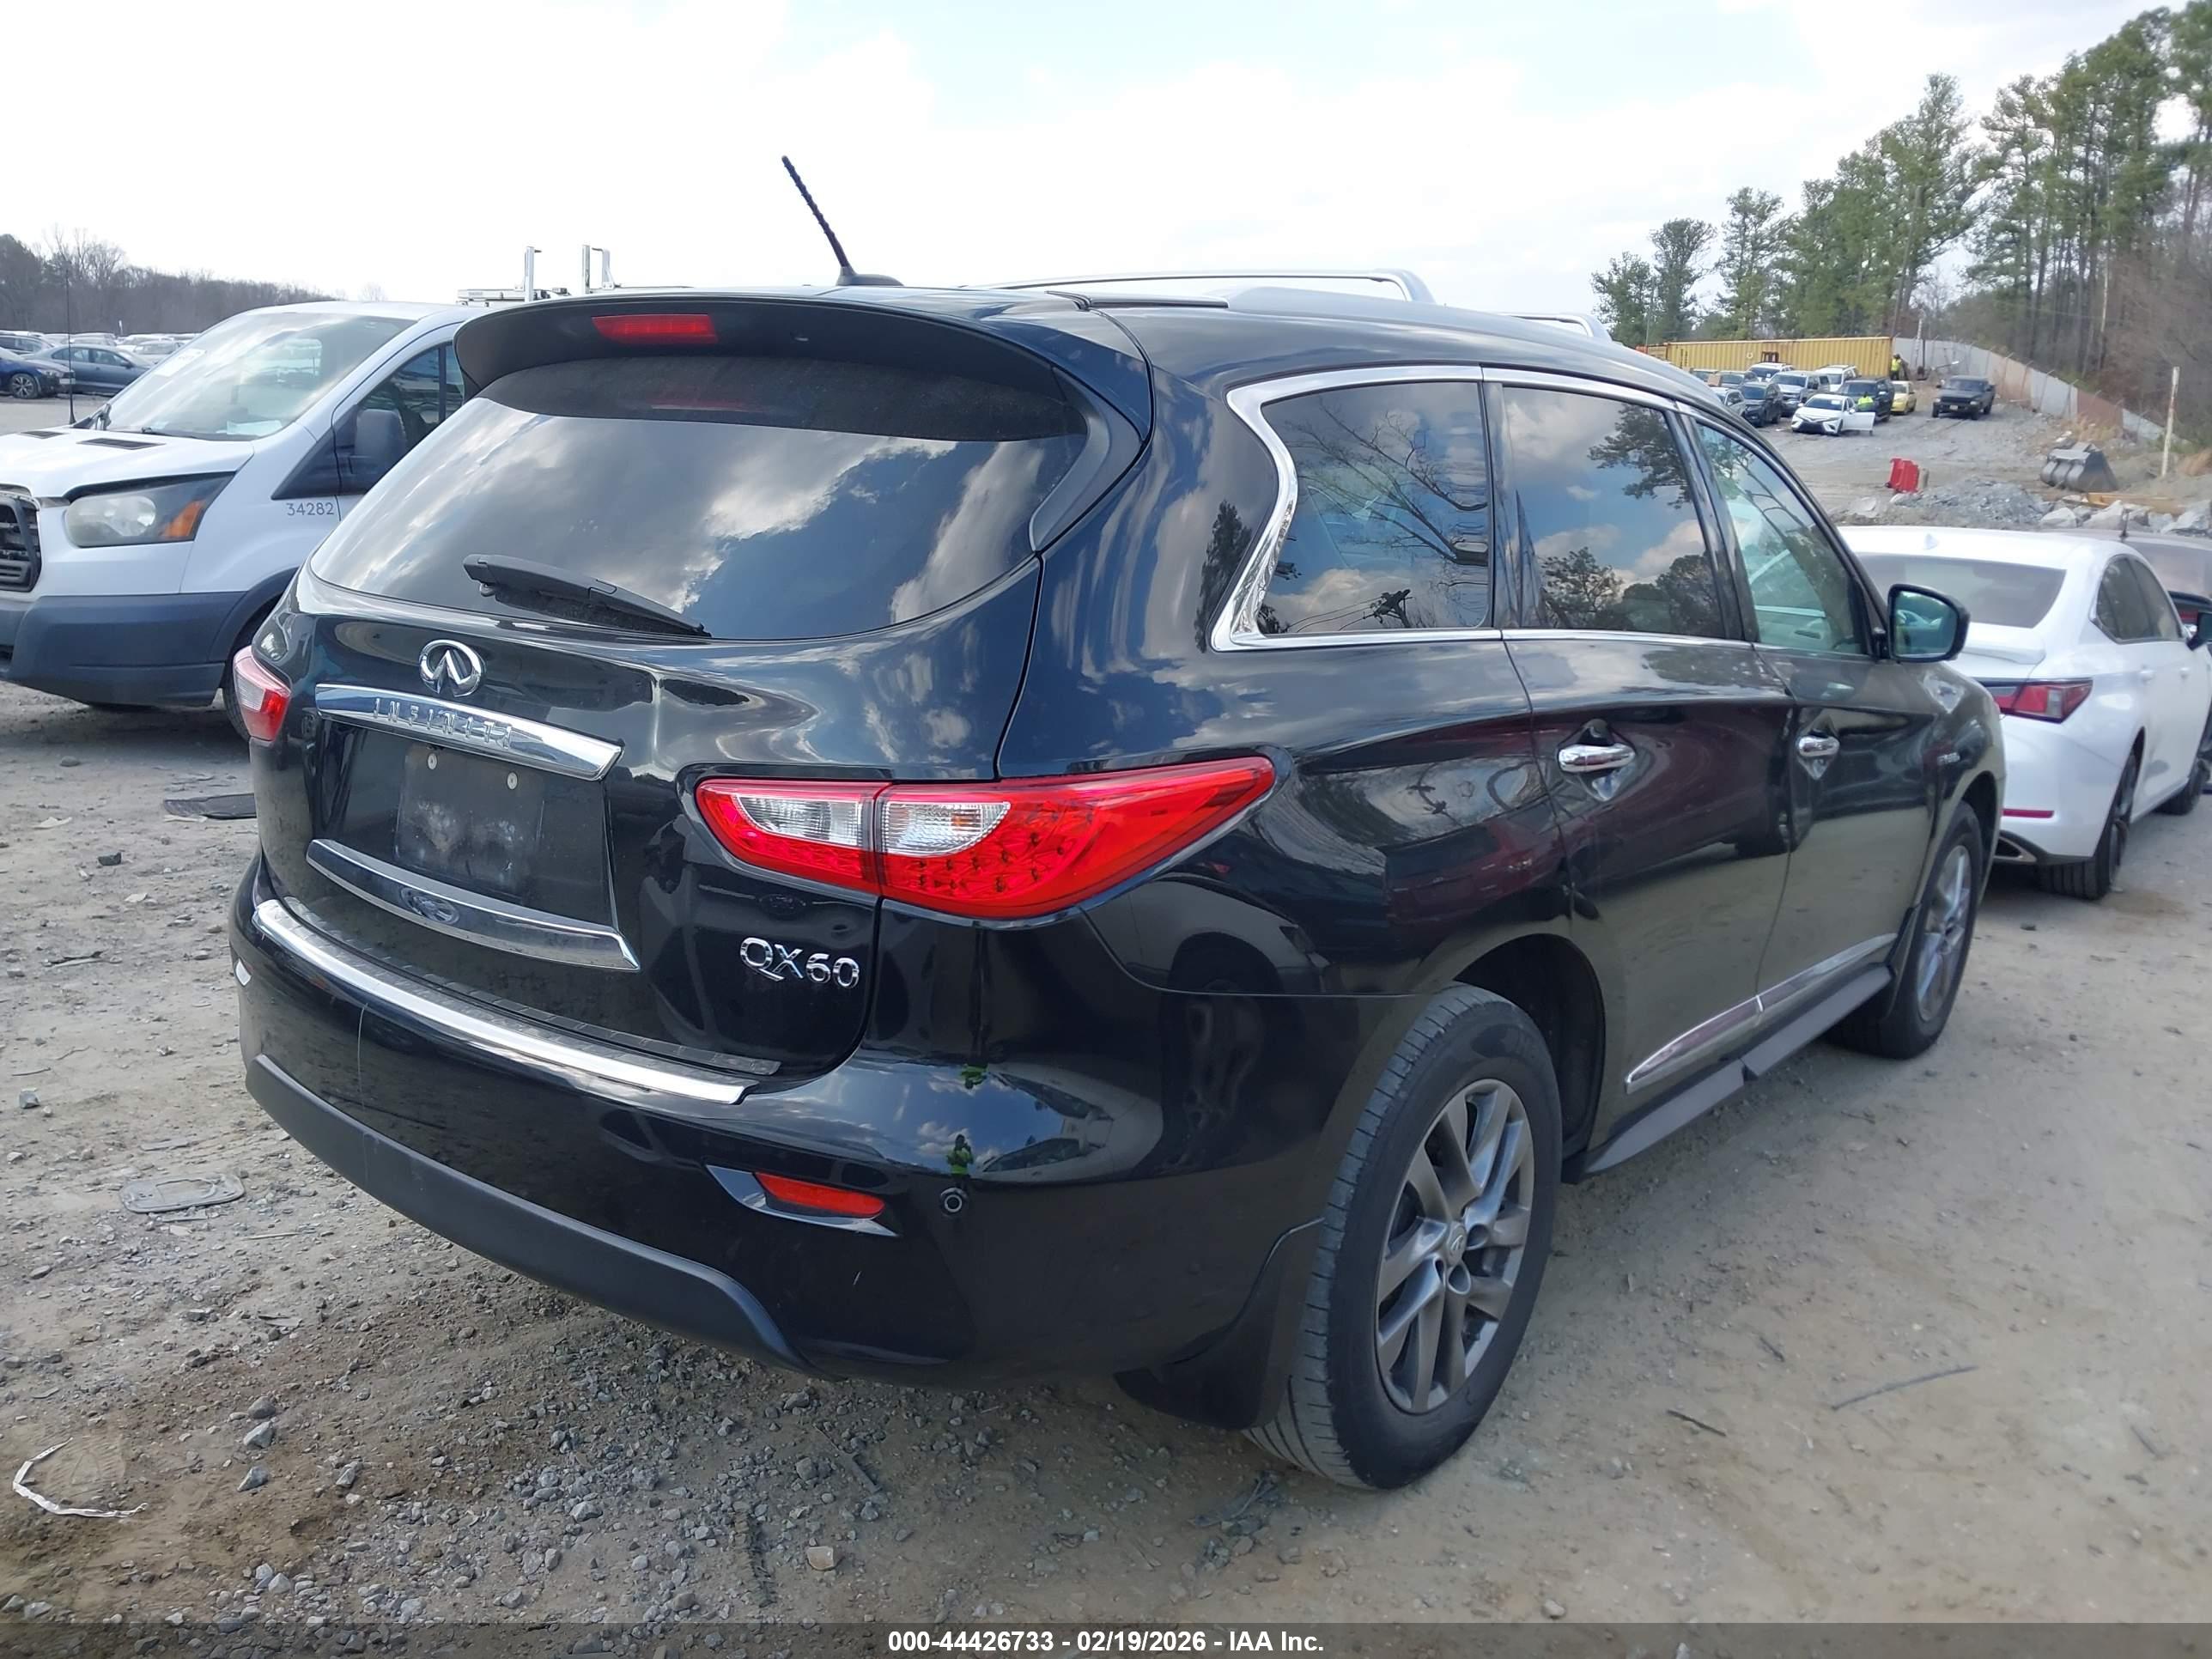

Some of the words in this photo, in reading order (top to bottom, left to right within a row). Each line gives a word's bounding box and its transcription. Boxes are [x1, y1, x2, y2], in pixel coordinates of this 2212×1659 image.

[286, 501, 334, 515] 34282
[374, 697, 513, 750] INFINITI
[740, 937, 860, 988] QX60
